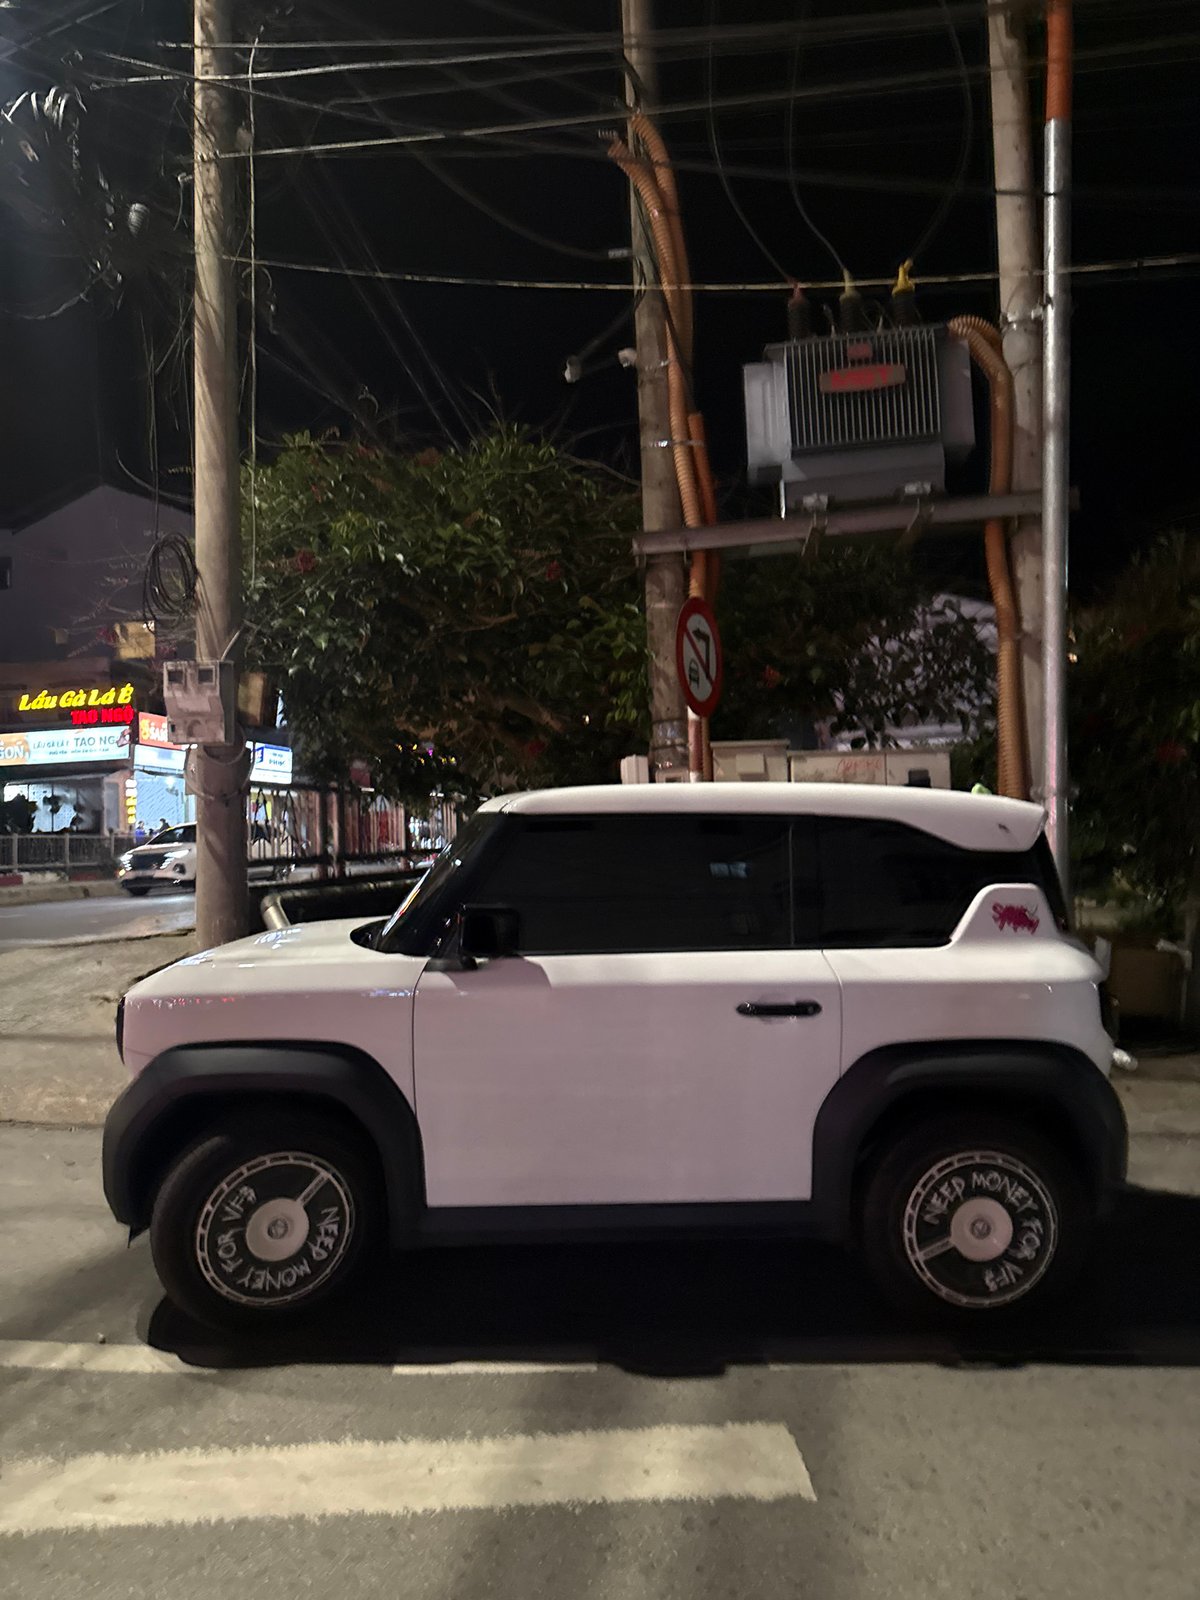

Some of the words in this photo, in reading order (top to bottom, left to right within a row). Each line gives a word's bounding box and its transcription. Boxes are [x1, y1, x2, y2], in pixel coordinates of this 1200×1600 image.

[71, 709, 98, 724] TAO
[73, 736, 96, 748] TAO
[972, 1170, 1039, 1213] MONEY
[217, 1227, 246, 1273] FOR
[236, 1257, 312, 1291] MONEY
